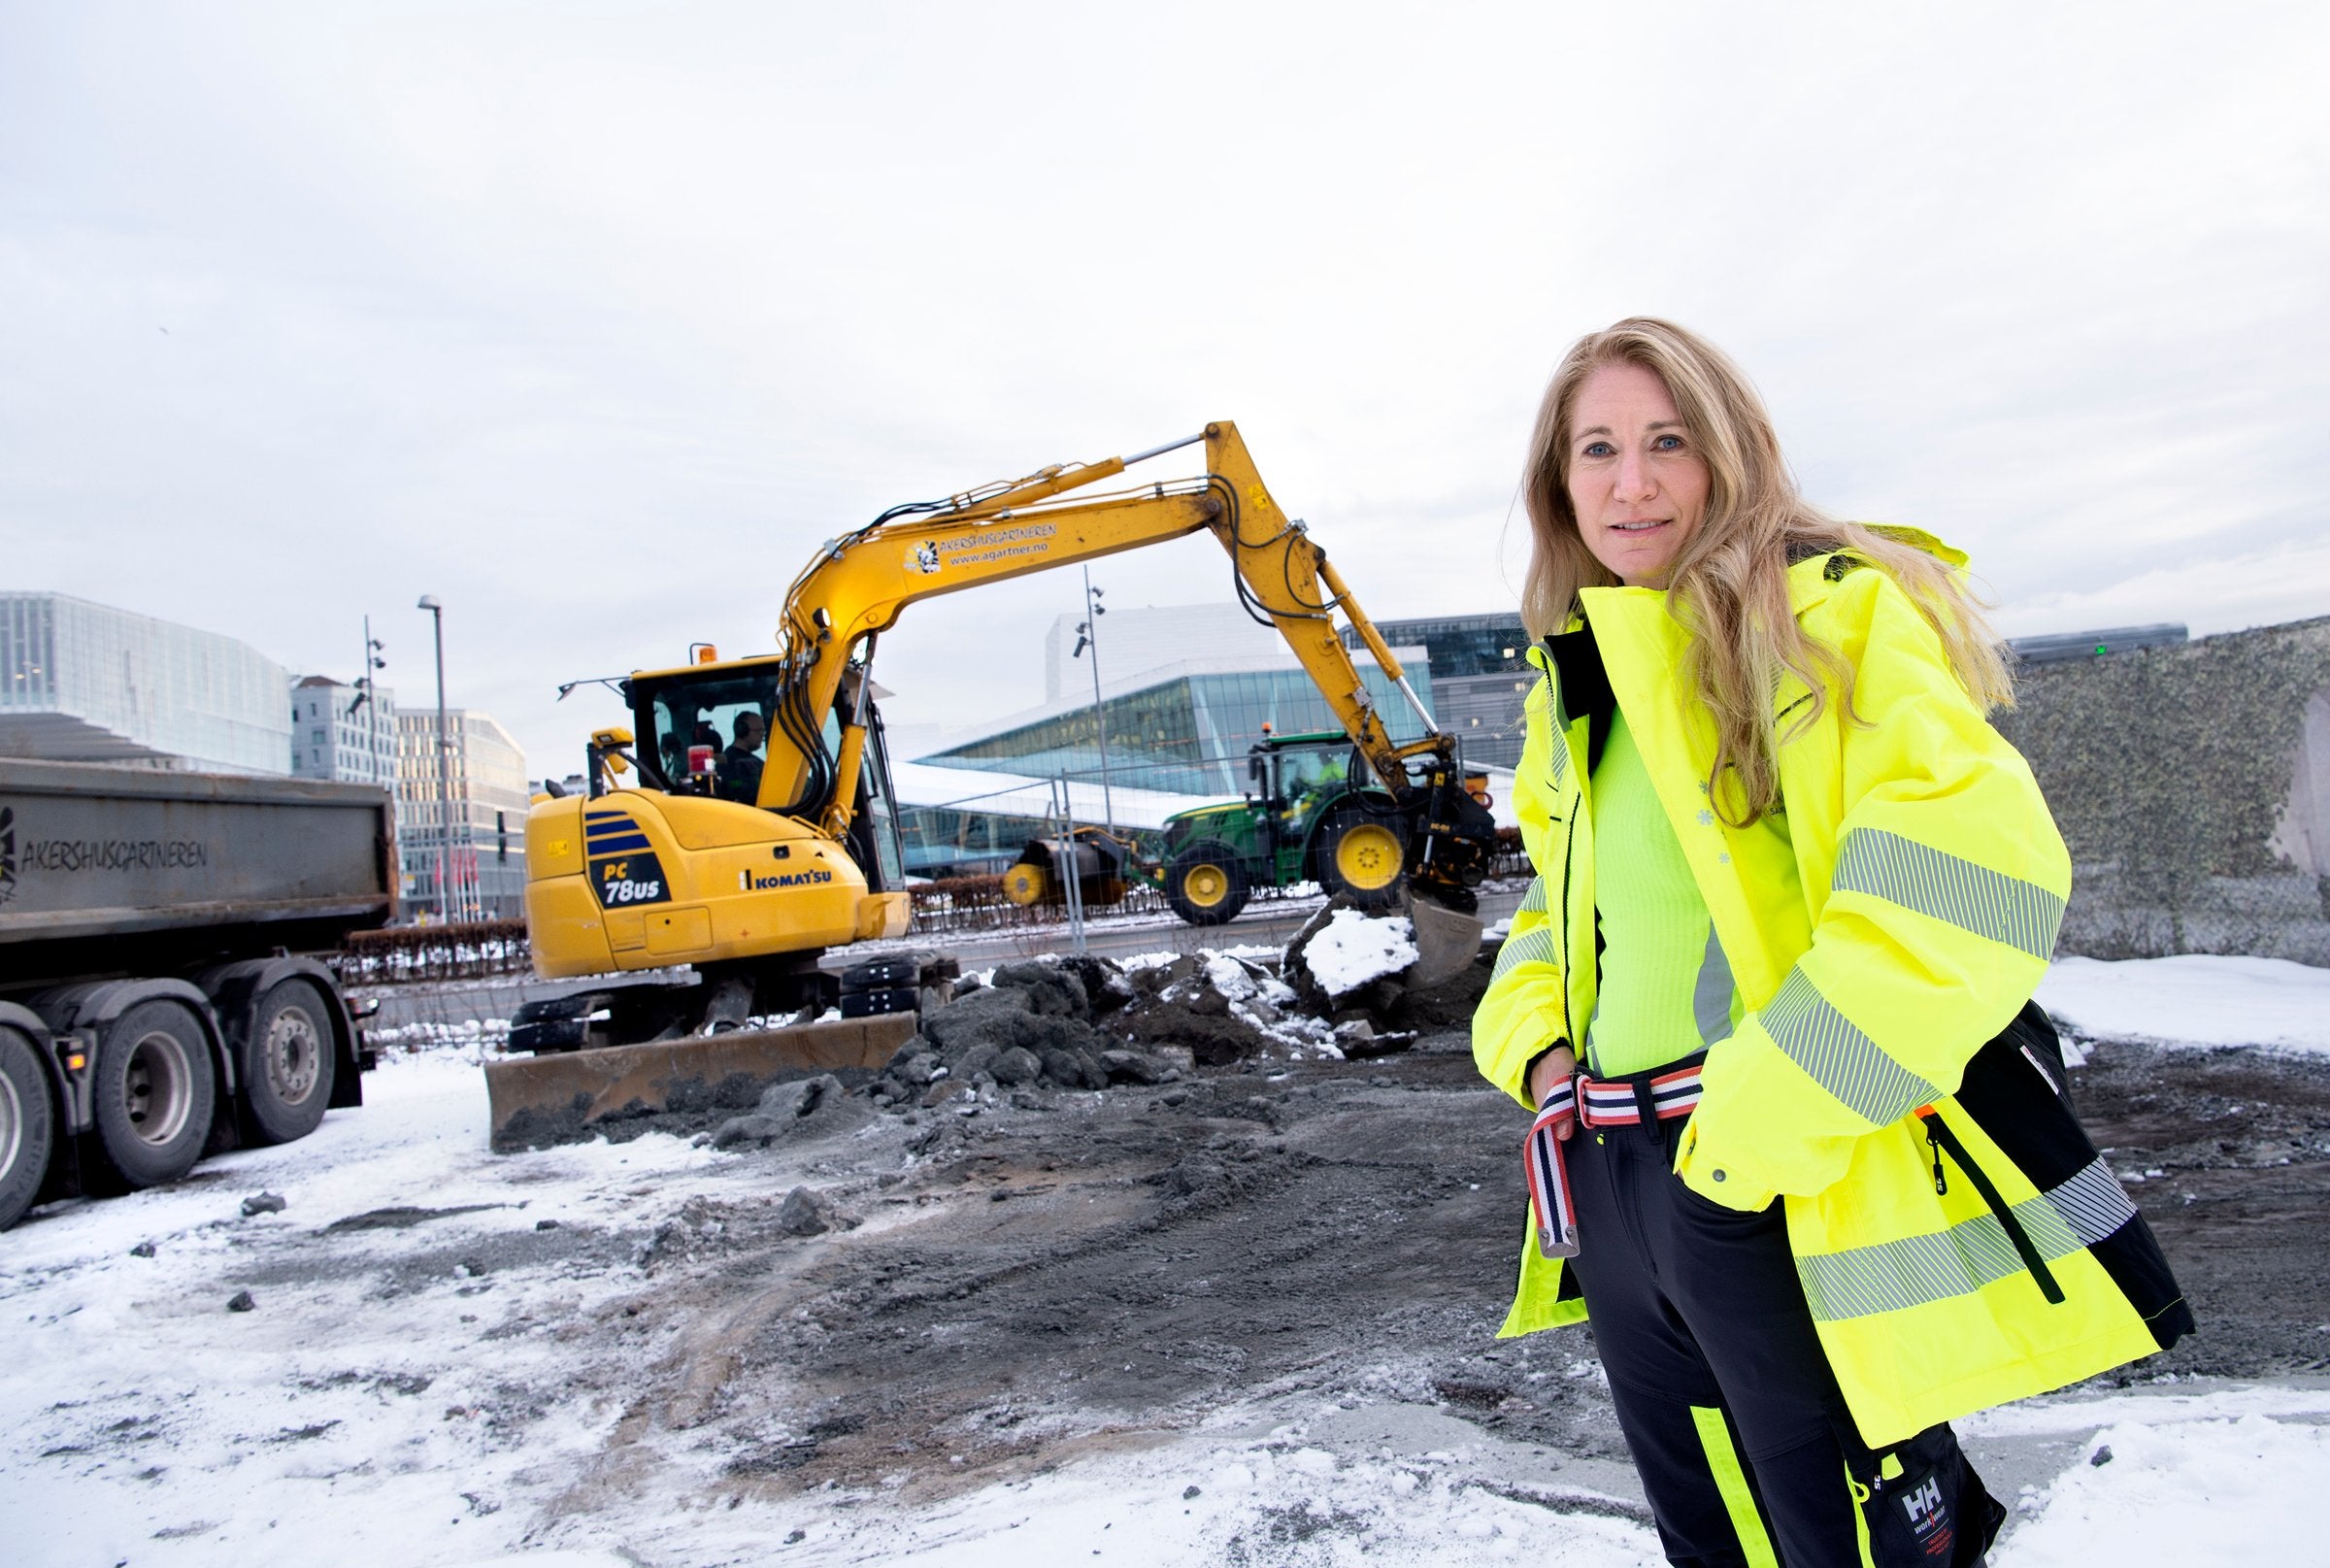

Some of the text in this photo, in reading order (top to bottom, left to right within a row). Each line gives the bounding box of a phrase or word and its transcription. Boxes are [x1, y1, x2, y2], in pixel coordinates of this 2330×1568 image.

[940, 524, 1057, 552] AKERSHUSGARTNEREN
[950, 543, 1048, 565] www.agartner.no
[21, 840, 208, 872] AKERSHUSGARTNEREN
[603, 861, 628, 882] PC
[755, 869, 832, 889] KOMATSU
[1902, 1476, 1942, 1521] HH
